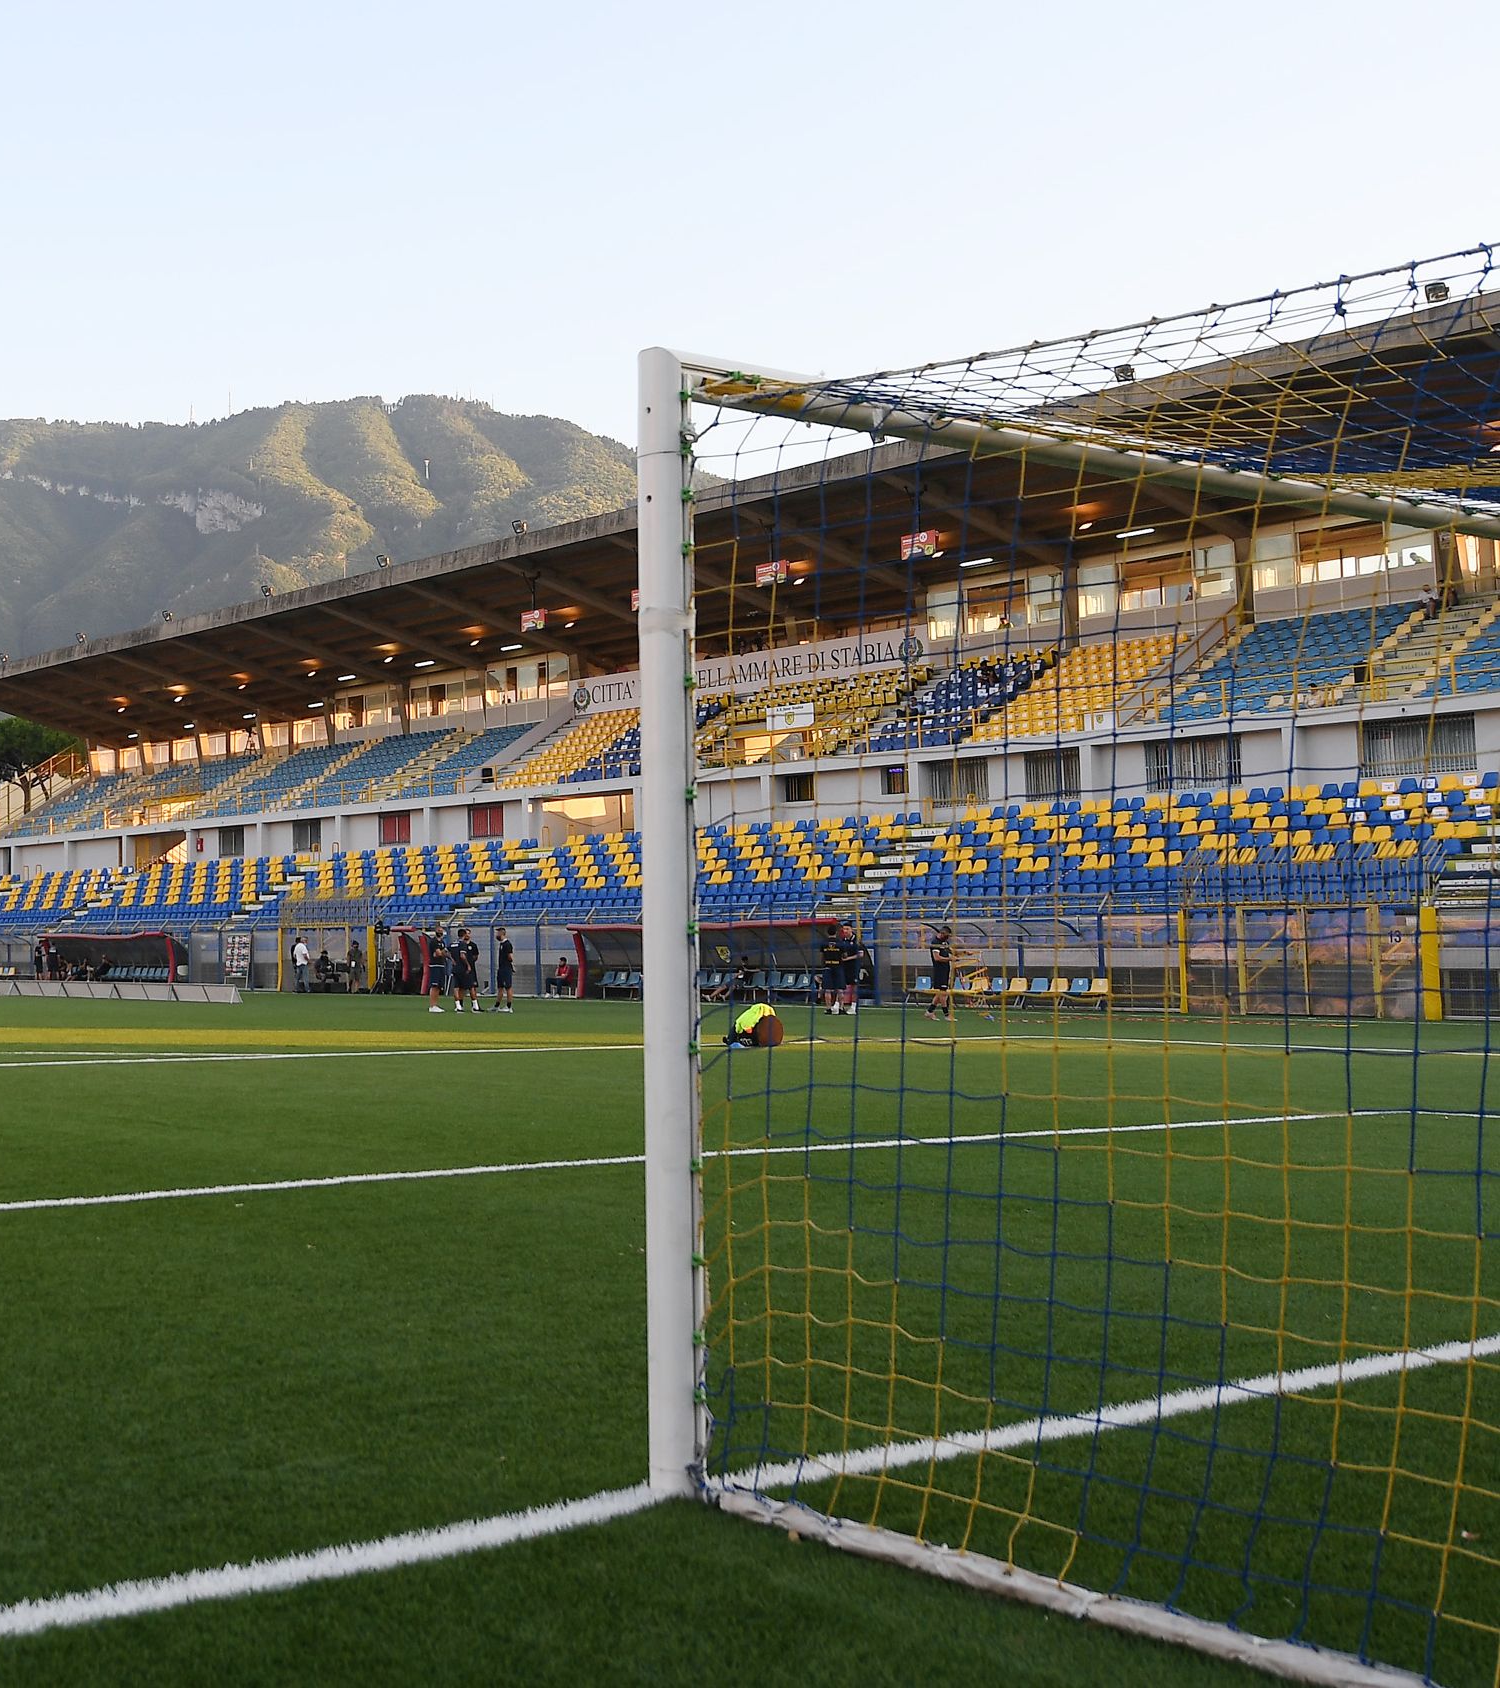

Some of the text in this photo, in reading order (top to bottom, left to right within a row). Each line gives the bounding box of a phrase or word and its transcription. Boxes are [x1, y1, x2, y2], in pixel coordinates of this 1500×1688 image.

[591, 641, 895, 704] CITTA' ELLAMMARE DI STABIA
[1387, 930, 1402, 943] 13
